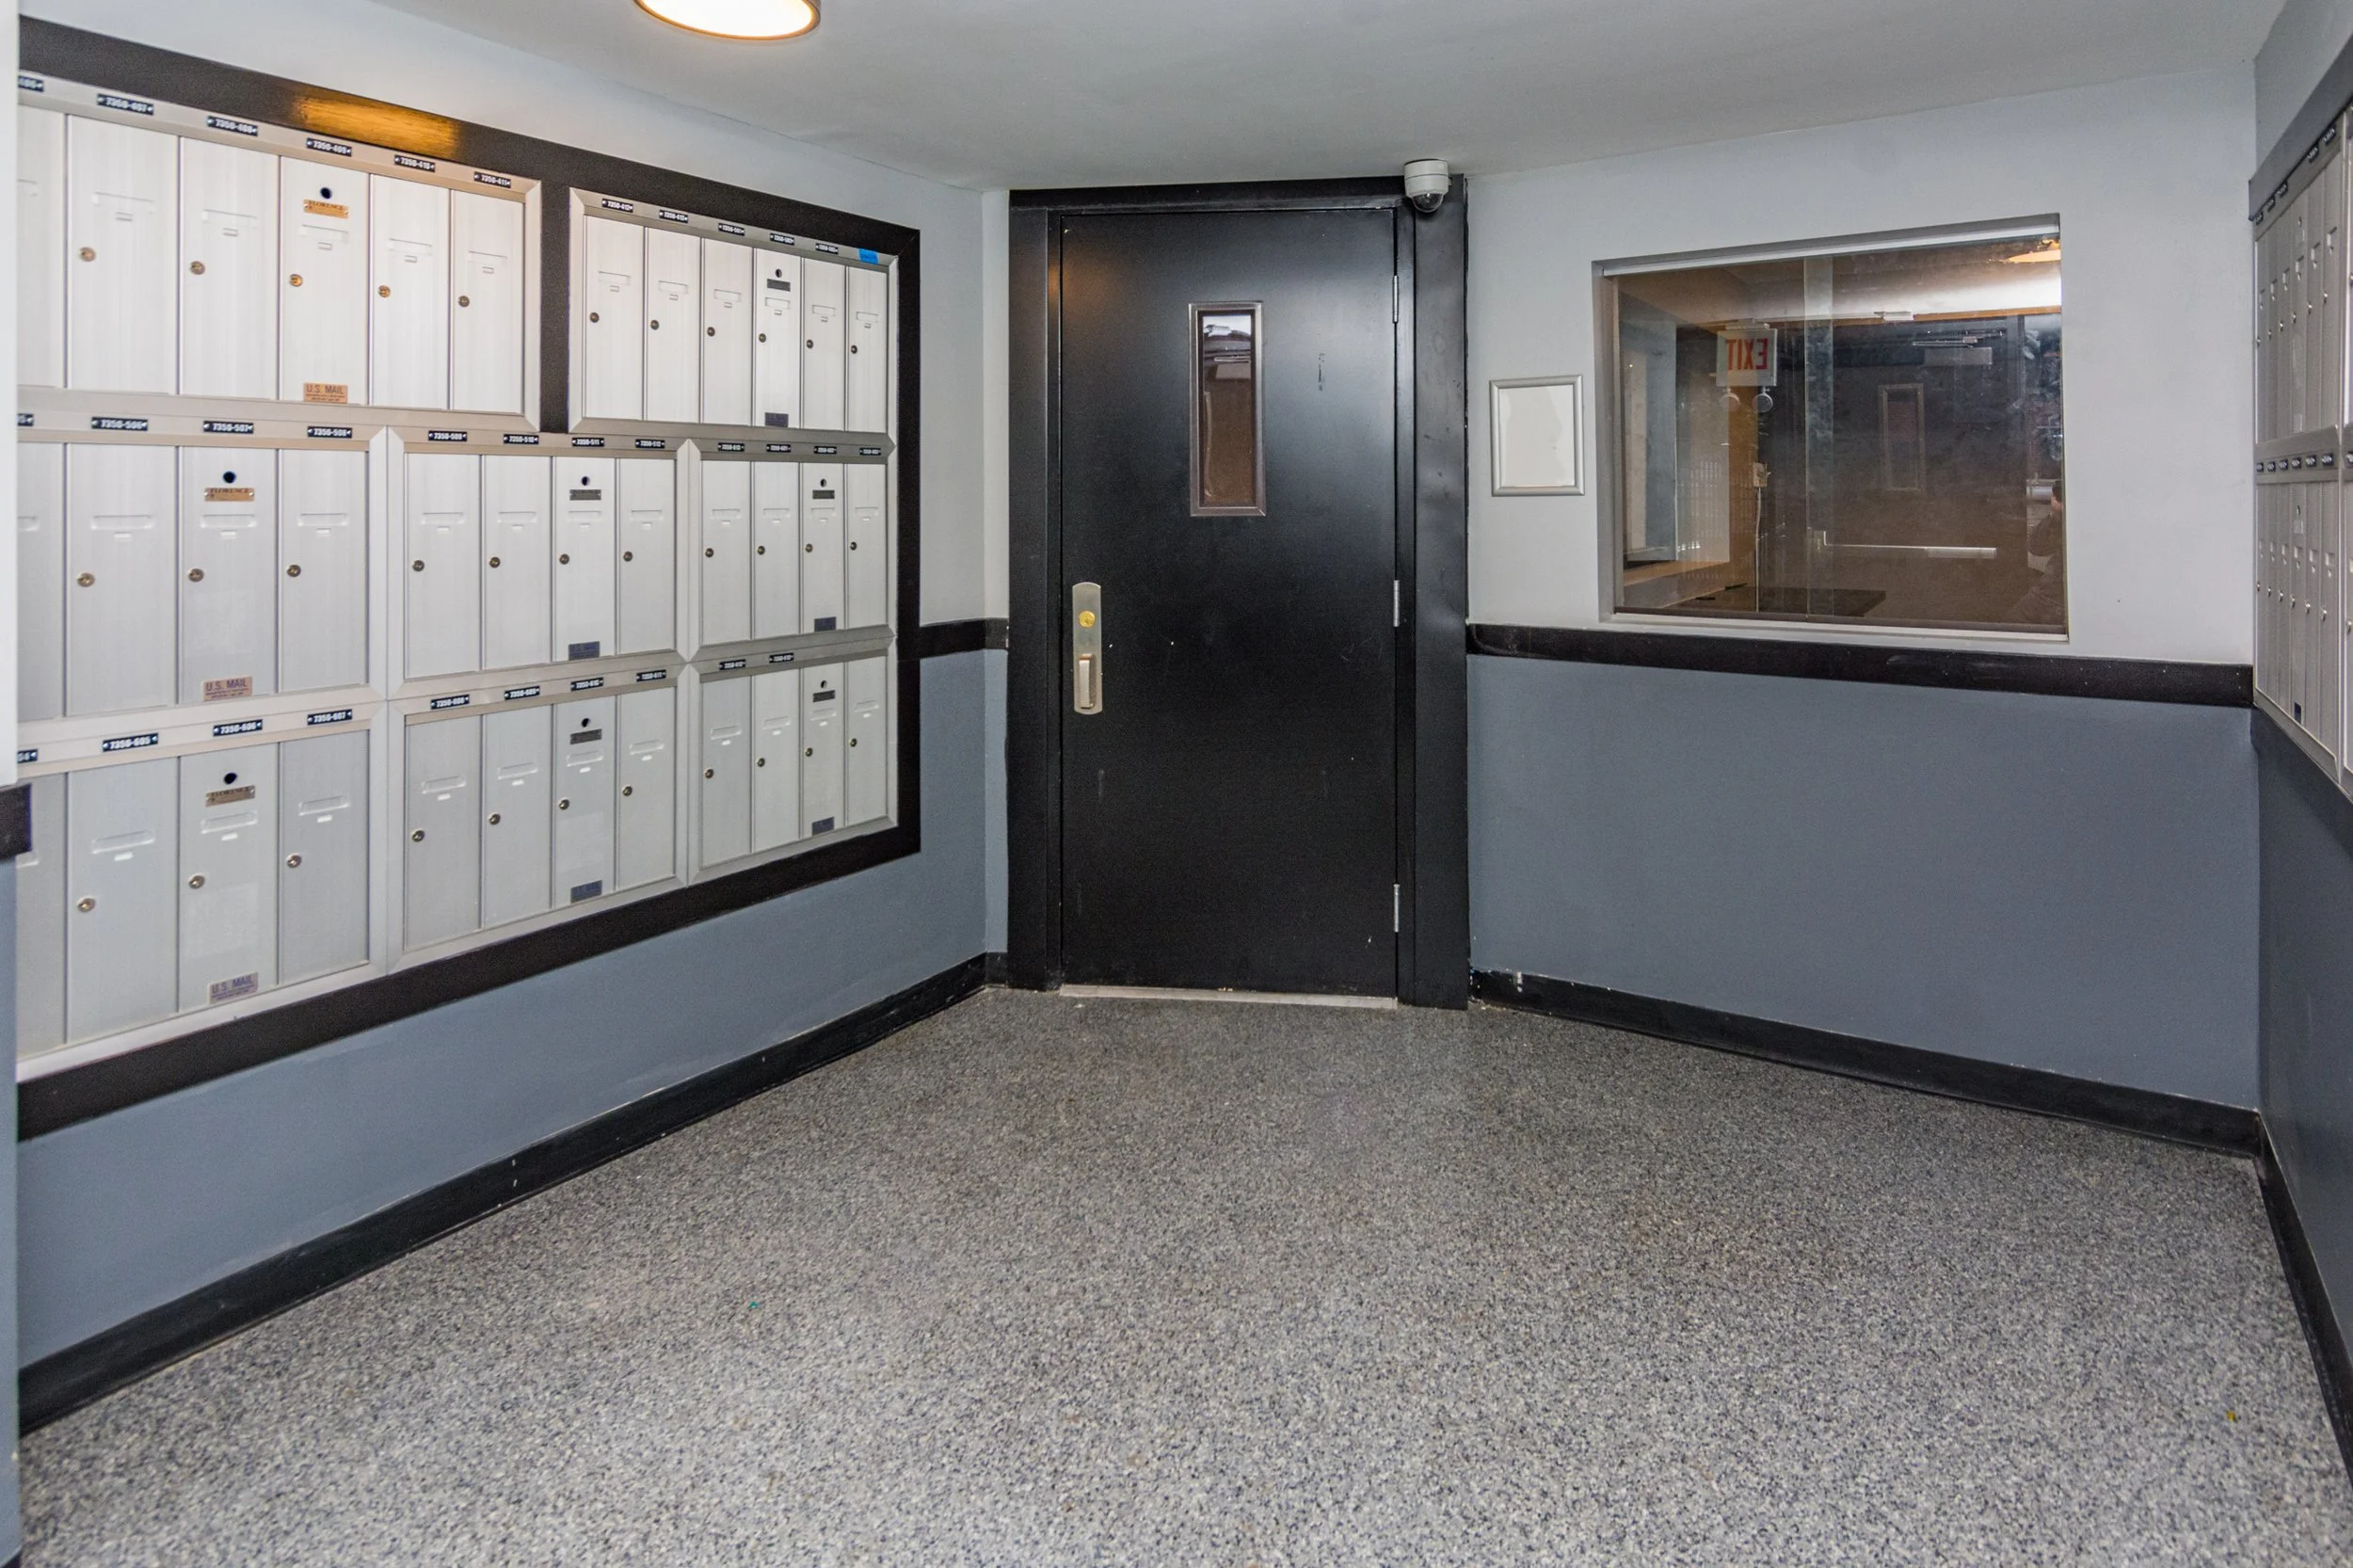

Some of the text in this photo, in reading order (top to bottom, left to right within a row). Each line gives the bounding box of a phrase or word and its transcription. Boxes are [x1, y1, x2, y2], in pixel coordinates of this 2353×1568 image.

[307, 384, 344, 394] U.S. MAIL
[213, 423, 248, 433] 7350-507
[314, 428, 346, 437] 7350-508
[434, 432, 463, 440] 7350-509
[206, 678, 247, 692] U.S. MAIL
[313, 712, 346, 724] 7350-607
[110, 737, 151, 750] 7350-605
[232, 975, 253, 988] MAIL
